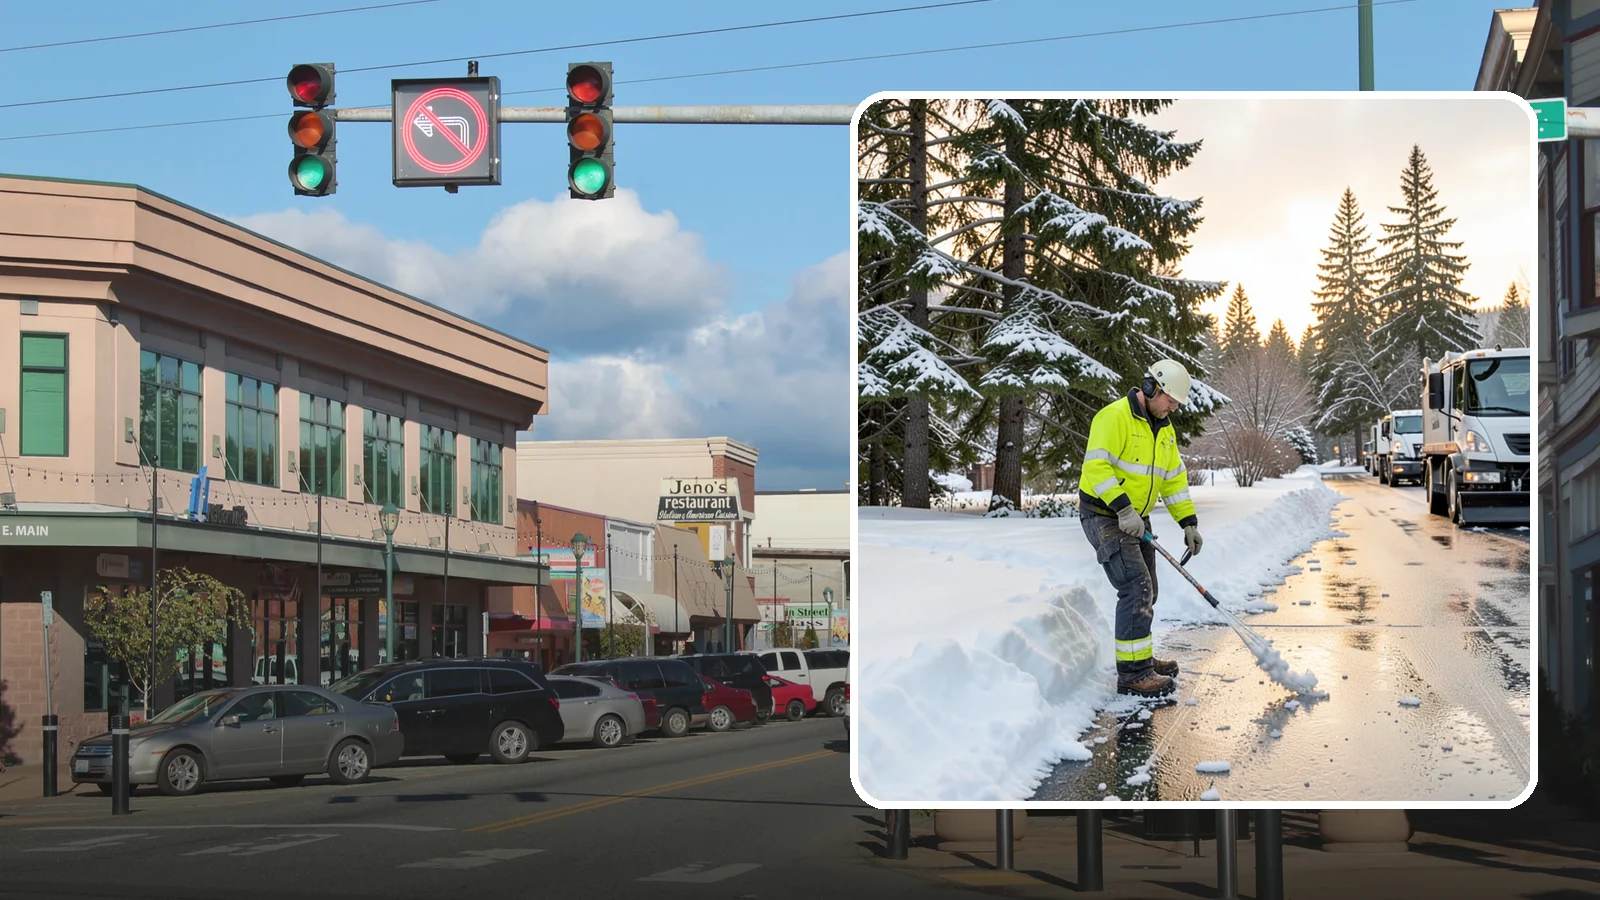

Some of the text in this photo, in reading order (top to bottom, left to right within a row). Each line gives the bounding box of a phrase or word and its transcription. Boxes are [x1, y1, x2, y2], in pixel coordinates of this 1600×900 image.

[670, 480, 727, 494] Jeno's
[665, 496, 731, 508] restaurant
[658, 509, 681, 519] Italian
[686, 510, 714, 519] American
[715, 509, 737, 519] Cuisine
[2, 525, 49, 536] E. MAIN
[797, 608, 828, 616] Street
